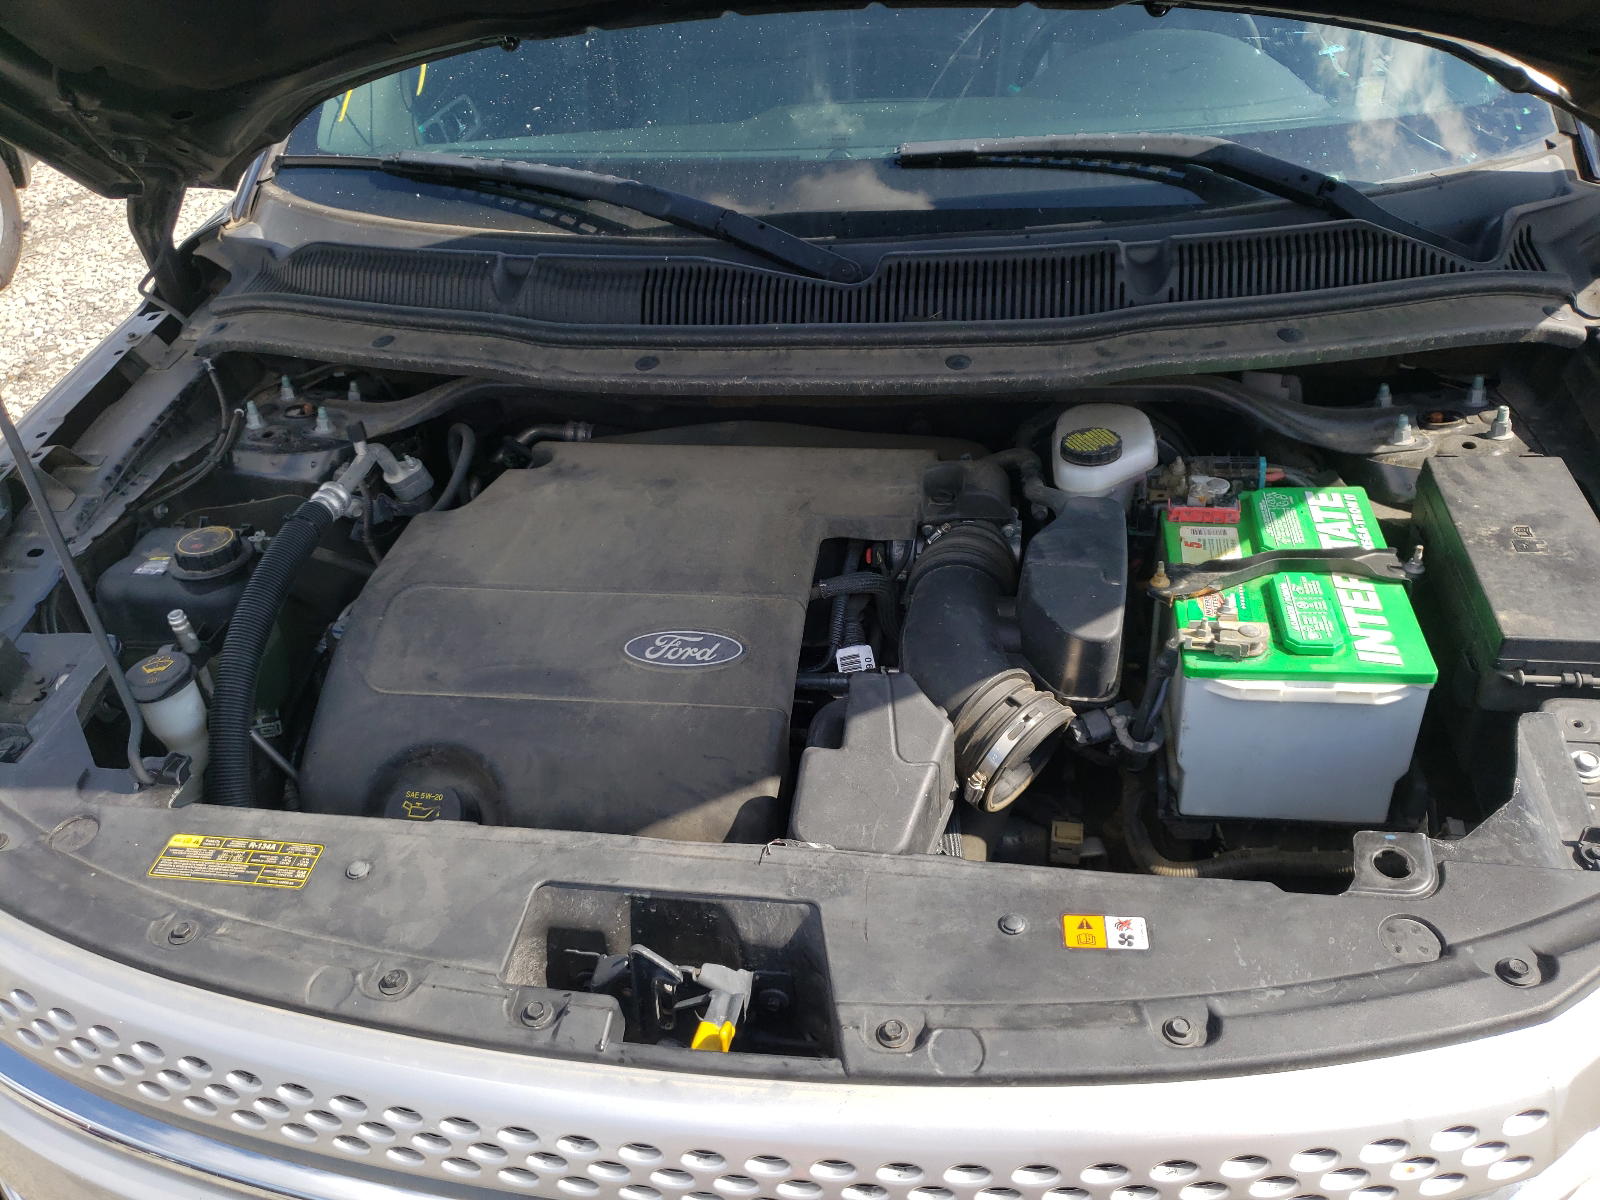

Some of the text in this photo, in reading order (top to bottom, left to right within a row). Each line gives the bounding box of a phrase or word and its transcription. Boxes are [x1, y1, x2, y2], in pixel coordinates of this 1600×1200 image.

[1305, 491, 1404, 666] INTERTATE
[645, 634, 721, 661] Ford
[405, 790, 444, 801] SAE 5W-20
[248, 841, 277, 851] R-134A
